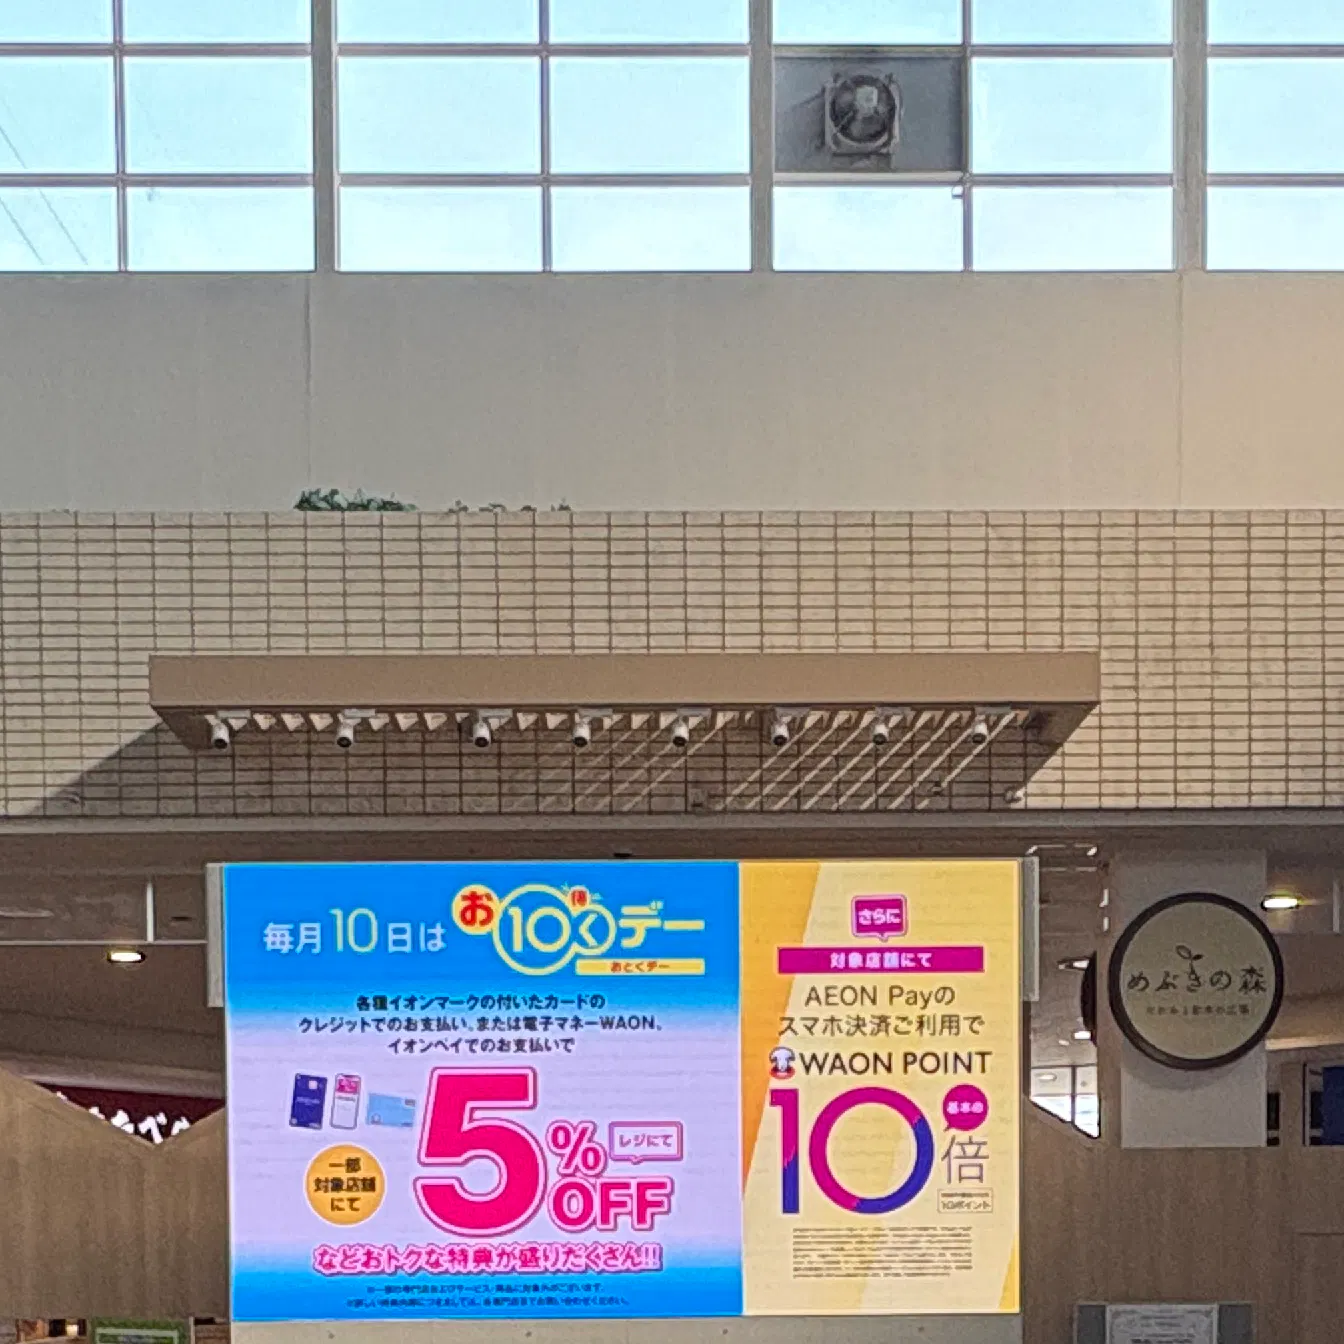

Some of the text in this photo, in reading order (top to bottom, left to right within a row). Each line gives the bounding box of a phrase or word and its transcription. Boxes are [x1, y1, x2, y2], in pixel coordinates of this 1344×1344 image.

[858, 908, 901, 925] さらに
[263, 908, 447, 954] 毎月10日は
[830, 952, 932, 969] 対象店舗にて
[1127, 965, 1267, 995] めぶきの森
[357, 994, 606, 1012] 各種イオンマークの付いたカードの
[805, 985, 956, 1010] AEON Payの
[778, 1014, 986, 1037] スマホ決済ご利用で
[388, 1037, 575, 1054] イオンペイでのお支払いで
[800, 1052, 993, 1075] WAON POINT
[618, 1133, 673, 1149] レジにて
[329, 1158, 362, 1172] 一部
[313, 1176, 377, 1194] 対象店舗
[330, 1197, 361, 1212] にて
[549, 1177, 674, 1231] OFF
